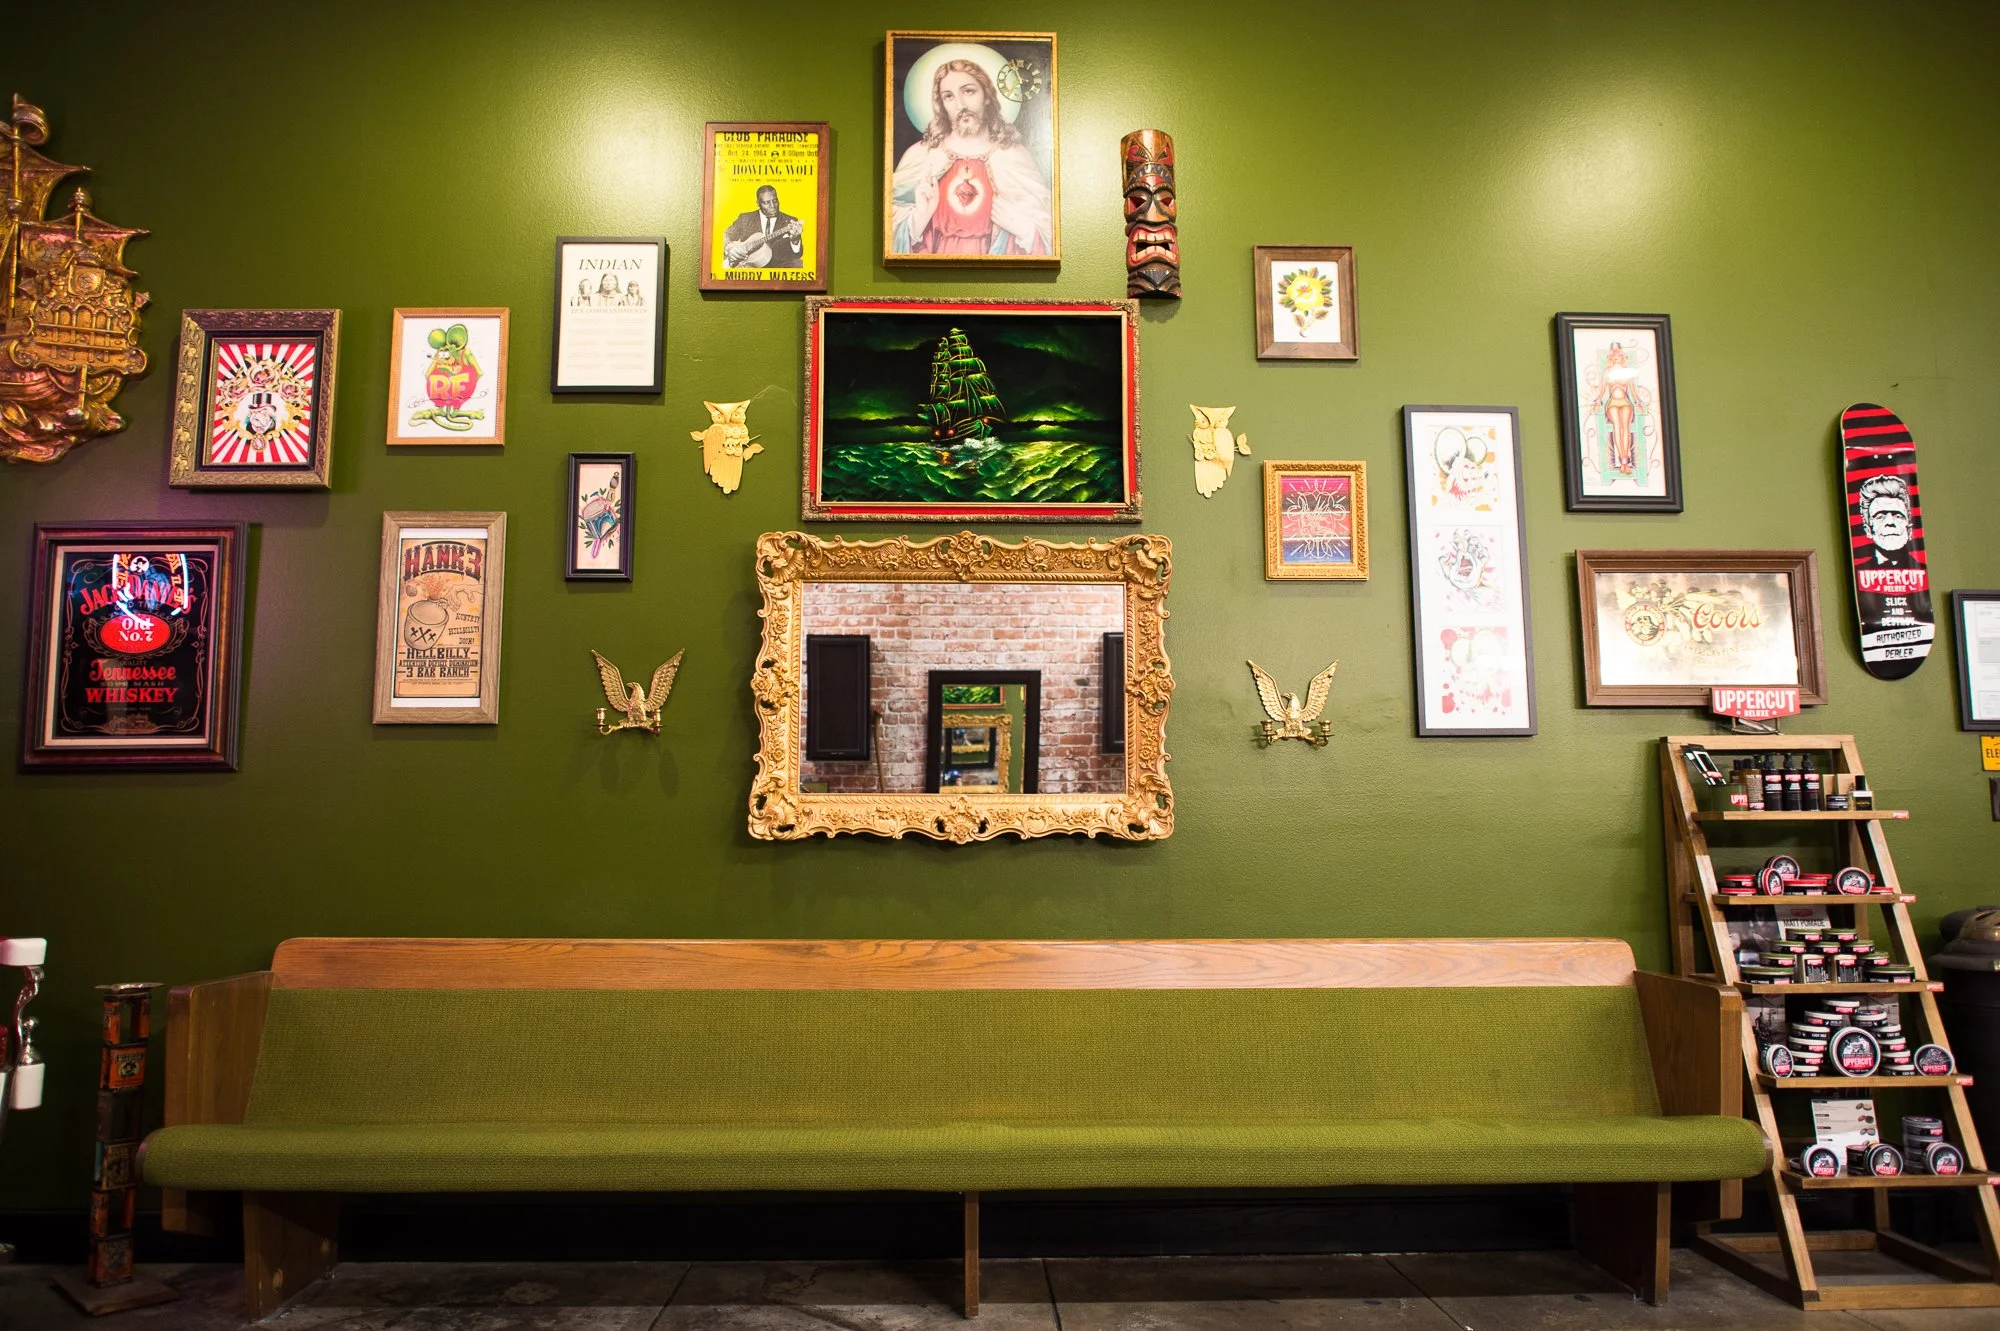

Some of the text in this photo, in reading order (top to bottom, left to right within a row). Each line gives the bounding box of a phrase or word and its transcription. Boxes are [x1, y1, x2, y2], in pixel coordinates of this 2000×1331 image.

[578, 258, 644, 271] INDIAN
[725, 271, 762, 281] MUDDY
[428, 372, 470, 400] RF
[1859, 569, 1926, 588] UPPERCUT
[1885, 597, 1908, 606] SLICK
[1693, 602, 1763, 631] Coors
[1876, 629, 1922, 644] AUTHORIZED
[1885, 648, 1914, 659] DEALER
[89, 659, 177, 681] Tennessee
[406, 667, 413, 678] 3
[439, 667, 470, 678] RANCH
[85, 687, 179, 703] WHISKEY
[1714, 689, 1796, 713] UPPERCUT
[1743, 709, 1770, 718] DELUXE
[1843, 1057, 1873, 1067] UPPERCUT
